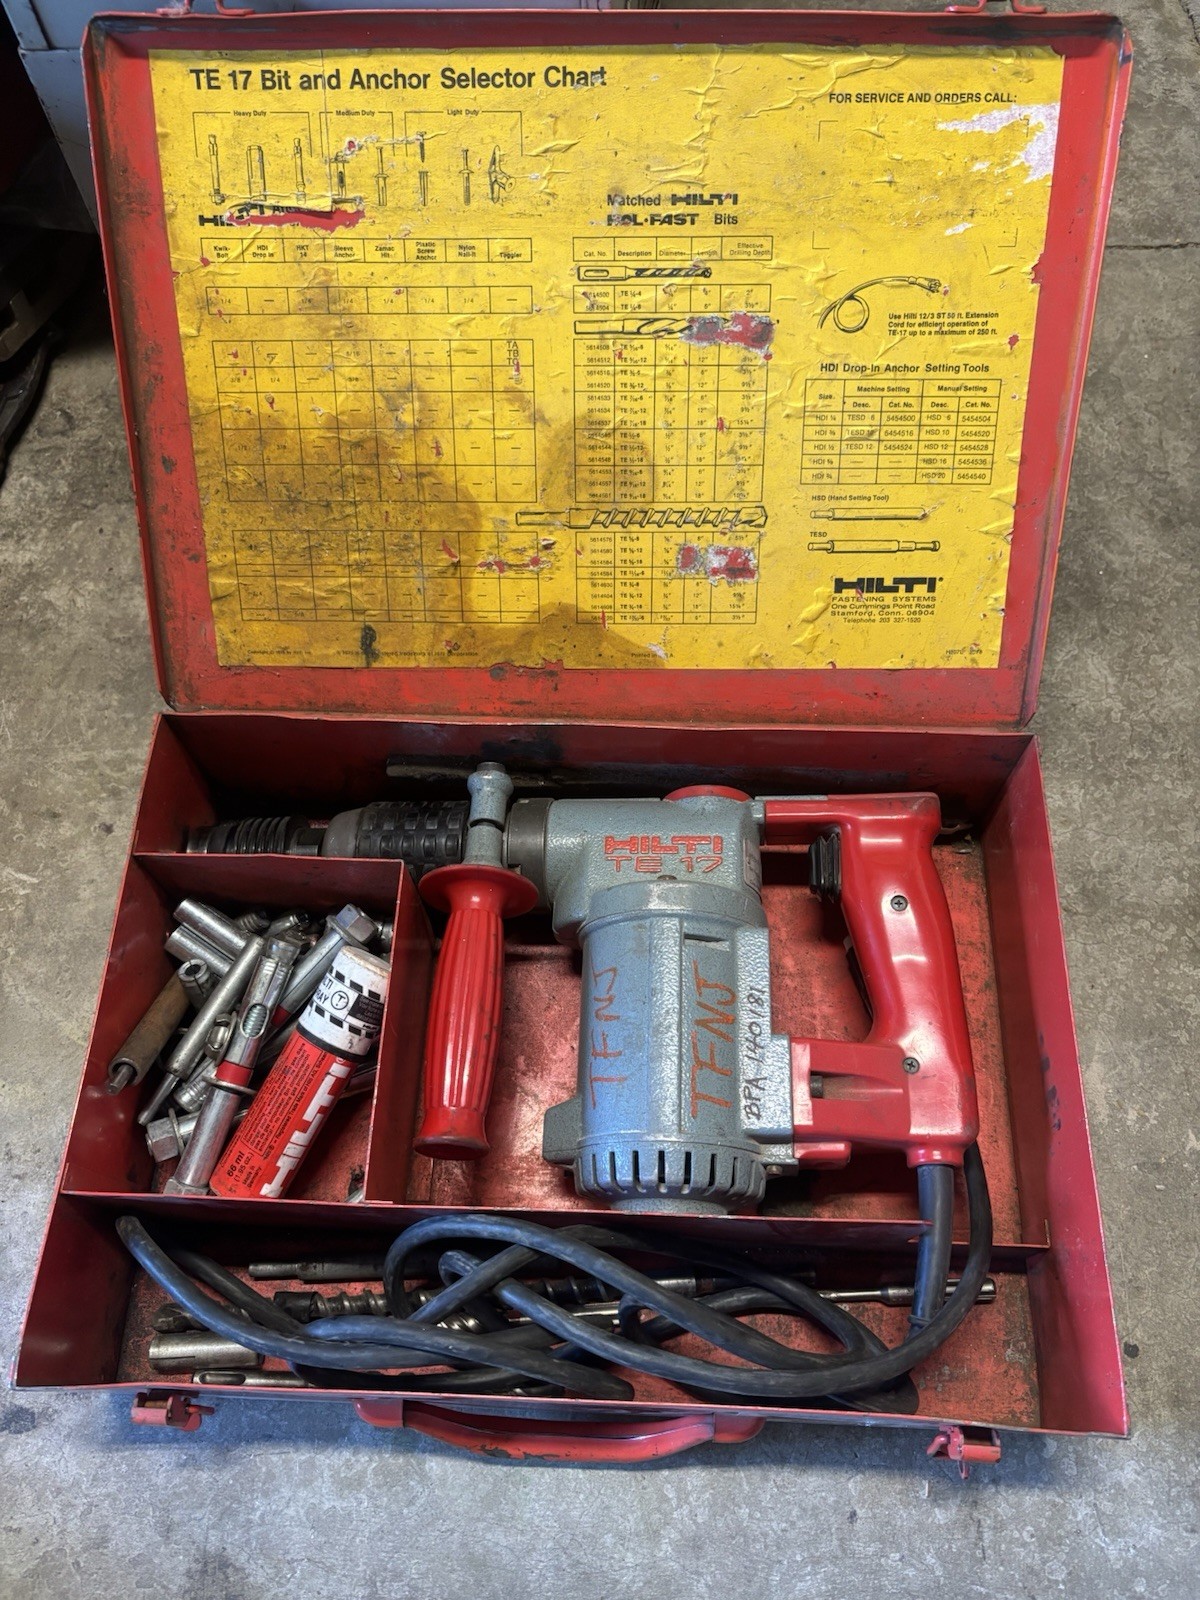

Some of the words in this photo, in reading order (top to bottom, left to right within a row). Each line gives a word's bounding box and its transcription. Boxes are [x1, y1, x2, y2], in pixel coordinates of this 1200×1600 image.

[190, 69, 220, 89] TE
[228, 70, 252, 89] 17
[261, 69, 291, 89] Bit
[300, 69, 341, 89] and
[350, 67, 430, 89] Anchor
[441, 66, 535, 89] Selector
[544, 66, 607, 88] Chart
[829, 93, 853, 103] FOR
[855, 93, 904, 103] SERVICE
[907, 93, 931, 103] AND
[934, 93, 982, 103] ORDERS
[984, 93, 1018, 103] CALL:
[233, 110, 252, 118] Heavy
[254, 110, 267, 118] Duty
[447, 109, 461, 117] Light
[463, 109, 480, 117] Duty
[607, 194, 660, 206] Matched
[671, 194, 738, 205] HILTI
[714, 214, 738, 224] Bits
[730, 249, 751, 257] Drilling
[753, 249, 771, 257] Depth
[947, 321, 977, 329] operation
[820, 364, 838, 372] HDI
[843, 364, 880, 374] Drop-In
[885, 364, 920, 373] Anchor
[925, 364, 960, 374] Setting
[963, 364, 989, 373] Tools
[887, 386, 910, 395] Setting
[963, 385, 987, 393] Setting
[828, 494, 847, 502] (Hand
[849, 494, 871, 502] Setting
[873, 494, 889, 502] Tool)
[834, 577, 936, 594] HILTI
[604, 836, 723, 854] HILTI
[605, 856, 662, 872] TE
[678, 856, 723, 873] 17
[260, 1062, 351, 1197] HILTI
[233, 1151, 245, 1164] ml
